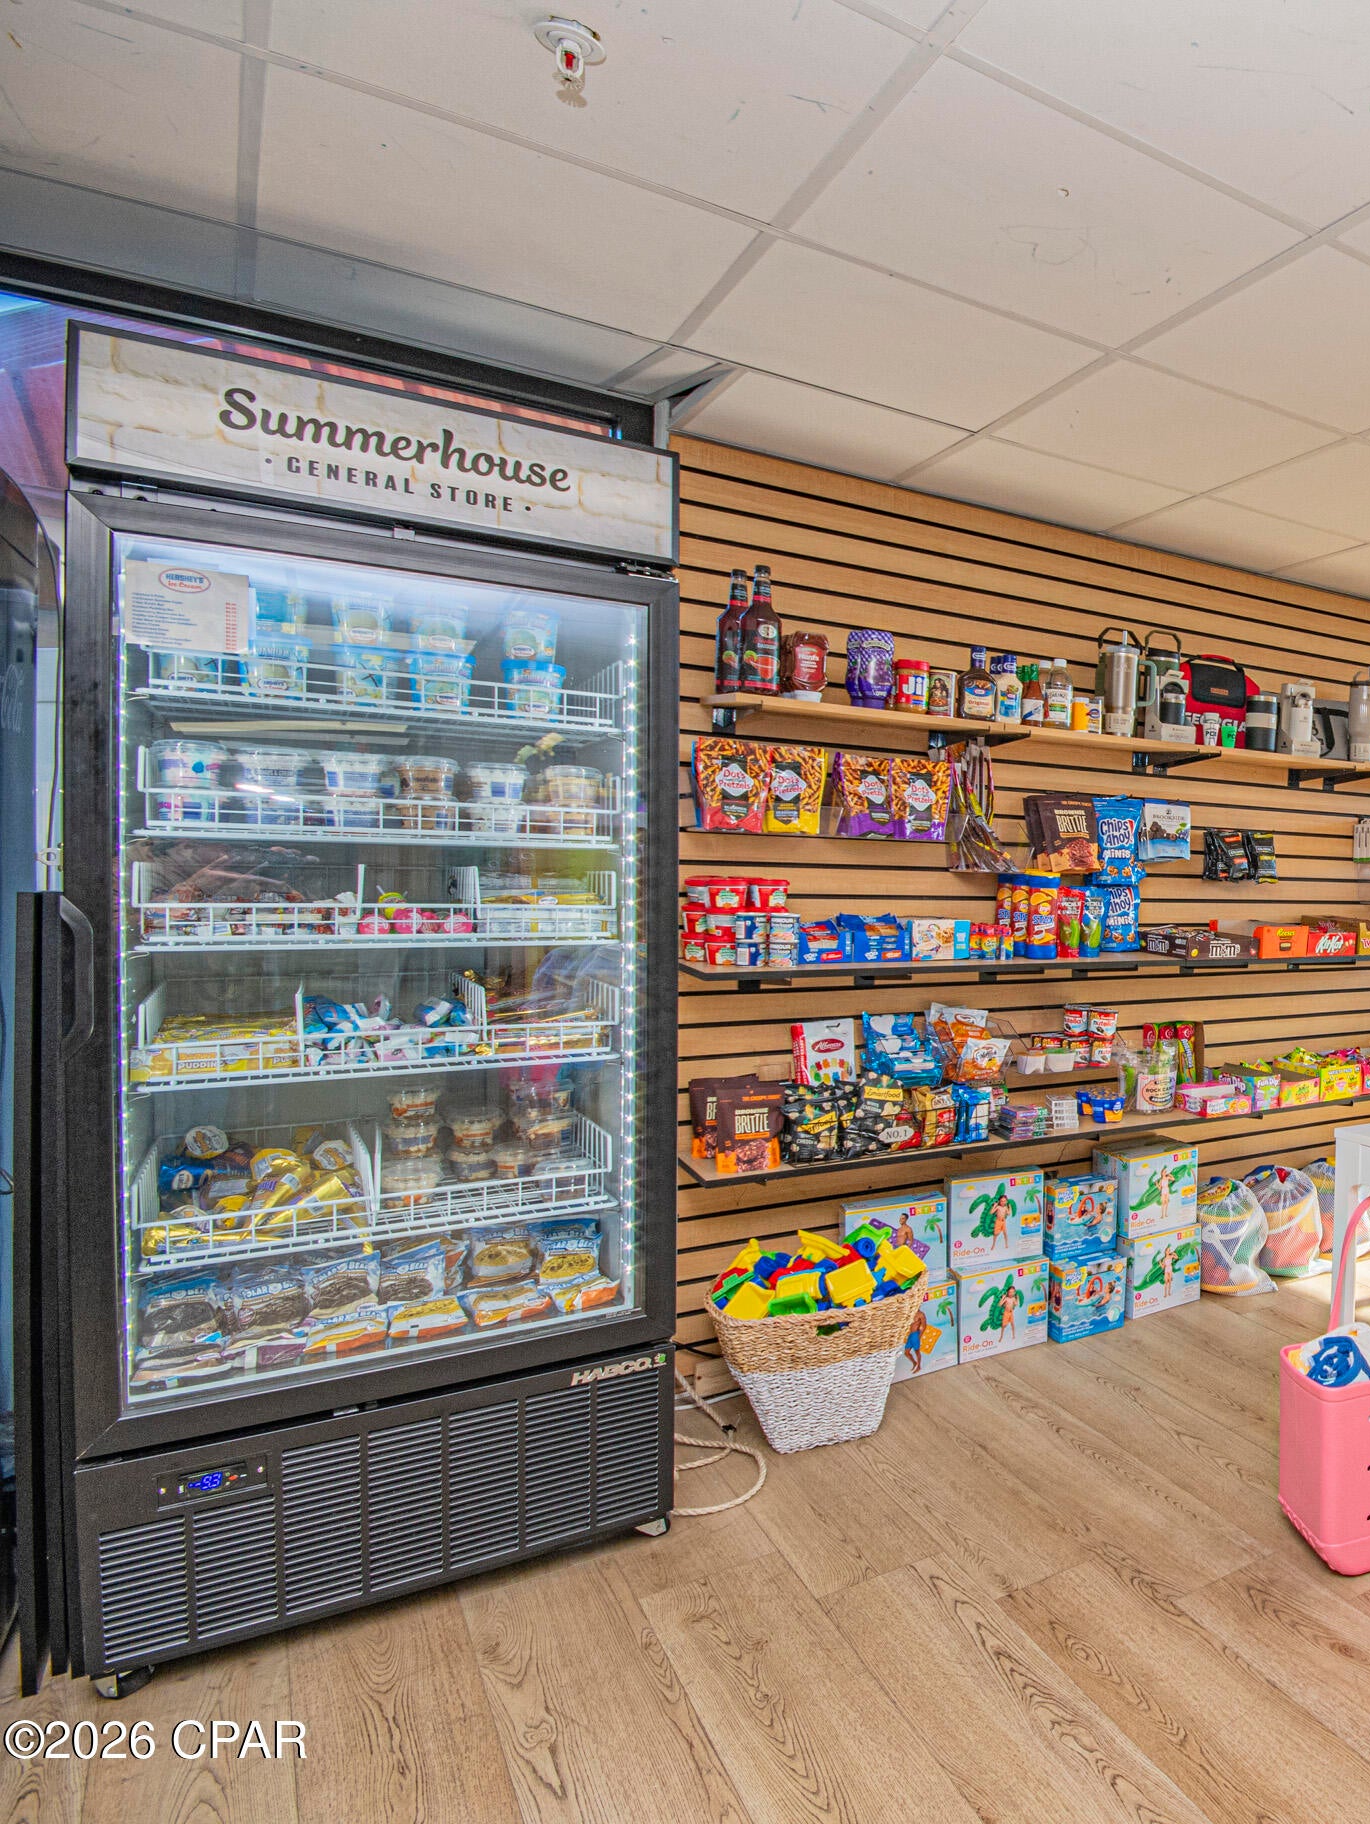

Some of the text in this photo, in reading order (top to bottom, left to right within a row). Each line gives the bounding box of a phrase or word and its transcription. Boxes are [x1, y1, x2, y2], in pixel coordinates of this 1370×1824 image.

[219, 387, 571, 492] Summerhouse
[287, 456, 513, 512] GENERAL STORE
[165, 573, 204, 584] HERSHEY'S
[902, 675, 926, 696] Ji
[723, 769, 746, 779] Dot's
[777, 775, 800, 785] Dot's
[718, 780, 751, 790] Pretzels
[773, 786, 803, 795] Pretzels
[907, 794, 934, 804] Pretzels
[1056, 814, 1089, 834] BRITTLE
[1100, 819, 1128, 837] Chips
[1232, 1076, 1246, 1092] Dip
[1257, 1077, 1280, 1088] Fun Dip
[735, 1112, 770, 1134] BRITTLE
[886, 1129, 908, 1139] NO. 1
[952, 1246, 986, 1258] Ride-On
[962, 1340, 994, 1353] Ride-On
[570, 1356, 652, 1387] HABCO
